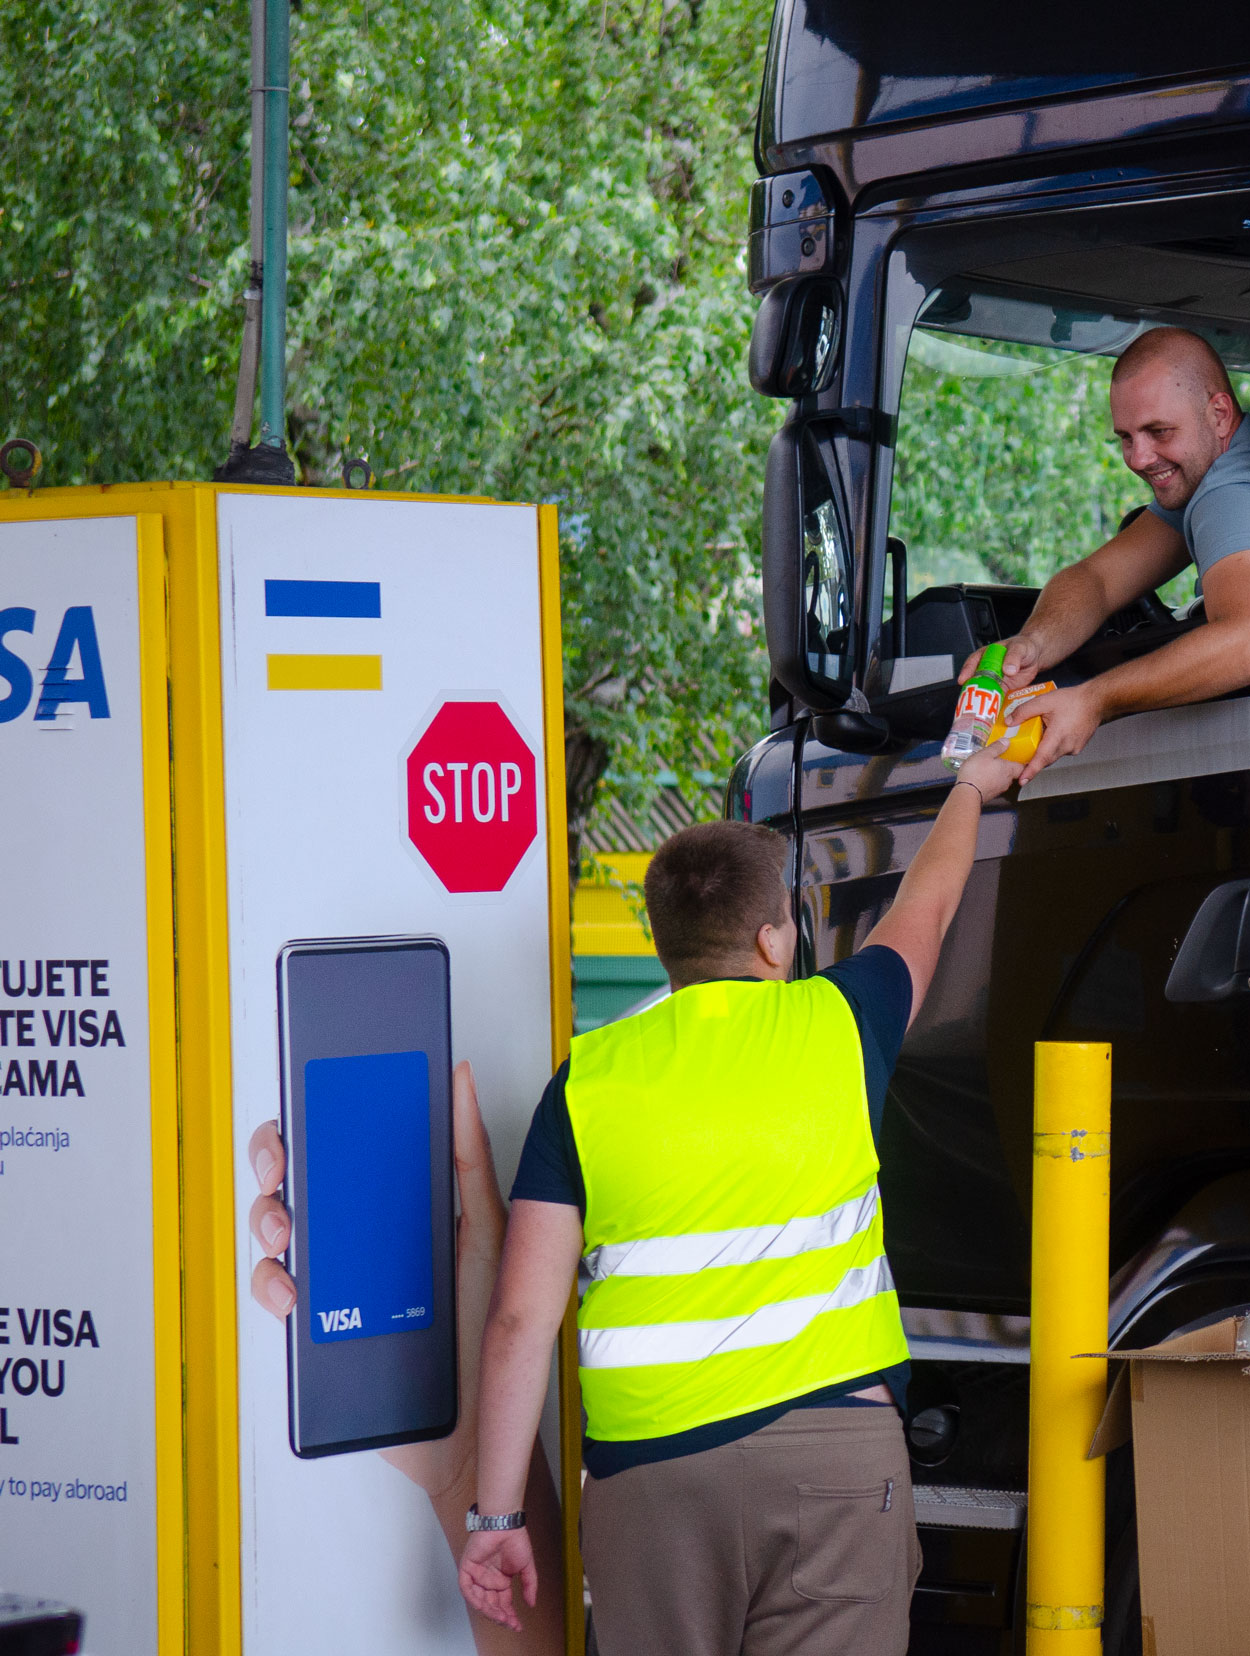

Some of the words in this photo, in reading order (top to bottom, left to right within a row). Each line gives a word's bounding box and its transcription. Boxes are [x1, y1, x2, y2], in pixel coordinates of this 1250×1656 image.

[423, 761, 522, 824] STOP
[0, 959, 110, 997] UJETE
[41, 1009, 127, 1048] VISA
[0, 1059, 86, 1097] AMA
[0, 1125, 70, 1152] plaćanja
[17, 1308, 101, 1348] VISA
[317, 1307, 363, 1333] VISA
[8, 1476, 27, 1496] to
[30, 1481, 62, 1503] pay
[64, 1478, 128, 1502] abroad
